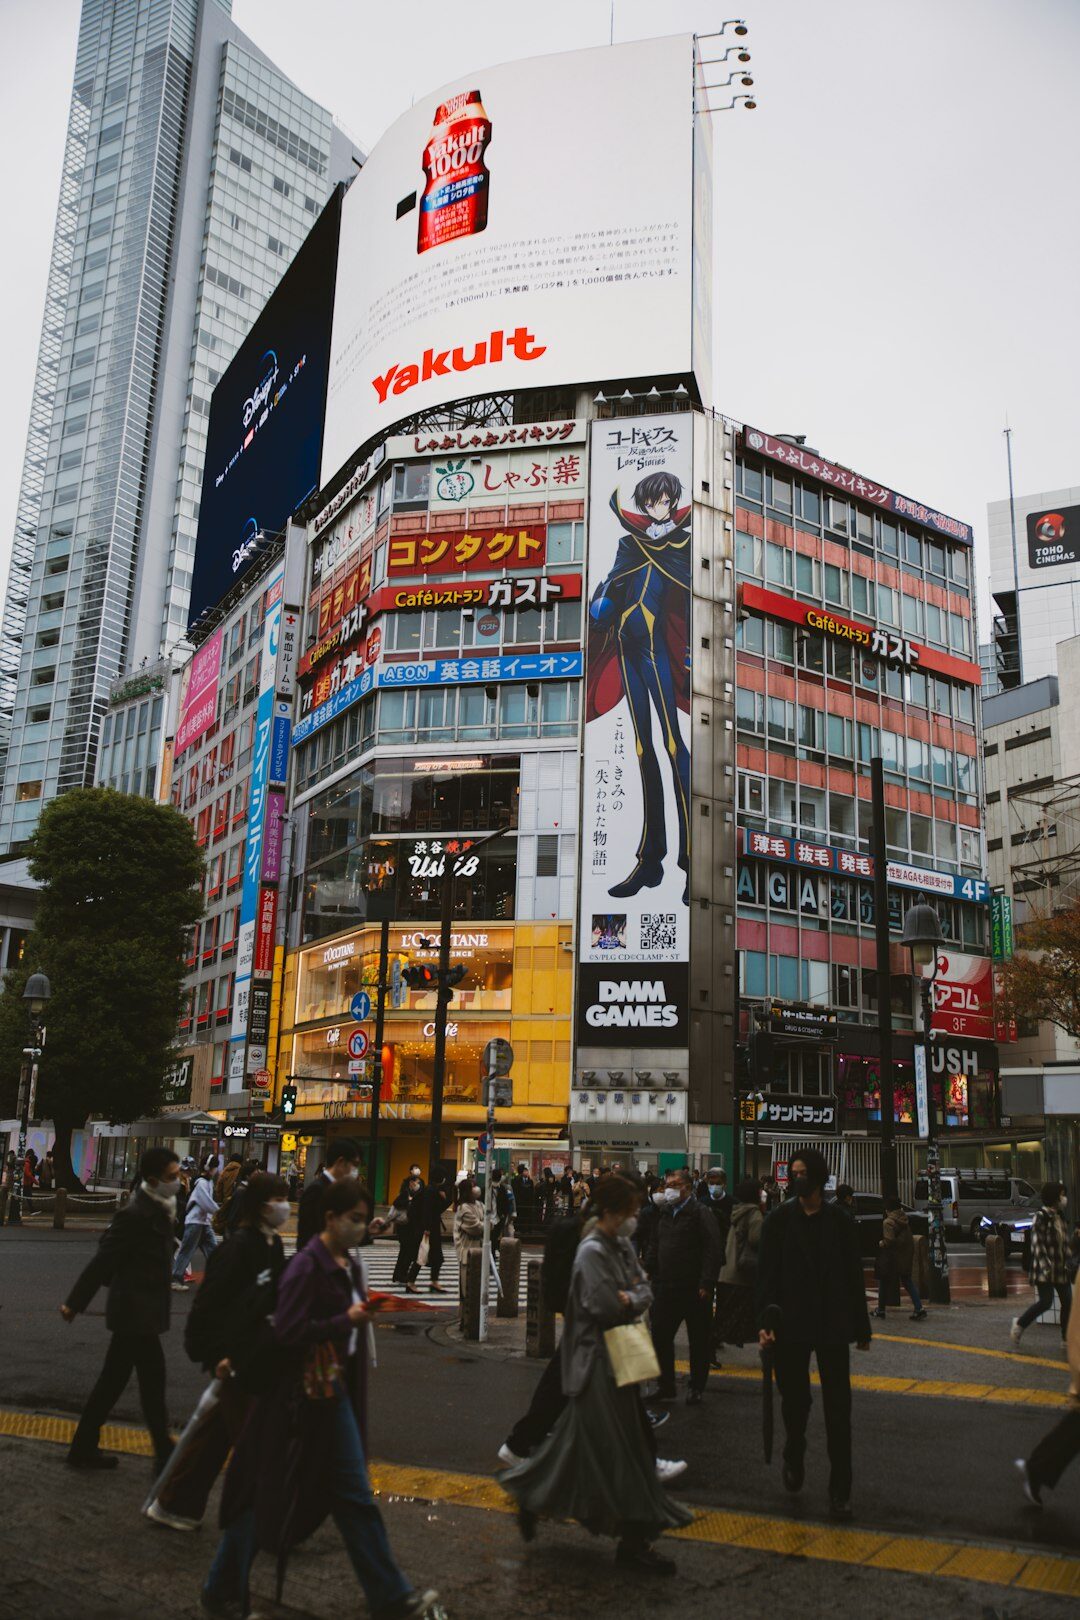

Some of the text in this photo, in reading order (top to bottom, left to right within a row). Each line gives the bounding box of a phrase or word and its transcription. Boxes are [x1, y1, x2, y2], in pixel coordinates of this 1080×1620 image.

[428, 125, 487, 161] Yakult
[427, 142, 483, 179] 1000
[371, 327, 547, 404] Yakult
[414, 422, 577, 453] しゃぶしゃぶバイキング
[606, 427, 679, 447] コードギアス
[484, 454, 581, 491] しゃぶ葉
[637, 456, 666, 471] Stories
[765, 436, 891, 504] しゃぶしゃぶバイキング
[391, 530, 541, 568] コンタクト
[1035, 545, 1064, 556] TOHO
[1036, 552, 1075, 564] CINEMAS
[320, 561, 371, 629] プライス
[488, 577, 561, 606] ガスト
[340, 603, 367, 644] ガスト
[282, 631, 294, 683] 献血ルーム
[871, 629, 919, 663] ガスト
[330, 650, 362, 699] ガスト
[383, 656, 578, 681] AEON 英会話イーオン
[303, 689, 314, 713] 7F
[313, 684, 359, 729] 英会話イーオン
[611, 717, 626, 811] これは、きみの
[248, 718, 271, 883] アイシティ
[592, 759, 610, 875] 「失われた物語」
[267, 808, 280, 868] 品川美容外科
[264, 871, 276, 879] 4F
[754, 833, 953, 892] 薄毛 抜毛 発毛 性型AGAも相談受付中
[737, 865, 818, 909] AGA
[961, 879, 986, 901] 4F
[261, 891, 275, 934] 外貨両替
[992, 898, 1002, 955] レイク ALSA
[1003, 898, 1012, 956] レイク ALSA
[401, 932, 489, 948] L'OCCTANE
[599, 980, 667, 1003] DMM
[935, 984, 980, 1011] アコム
[423, 1022, 459, 1037] Cfé
[585, 1004, 679, 1028] GAMES
[952, 1017, 967, 1031] 3F
[931, 1046, 978, 1076] USH
[323, 1100, 413, 1119] L'OCCITNE
[768, 1103, 834, 1123] サンドラッグ
[578, 1139, 609, 1147] SHIBUYA
